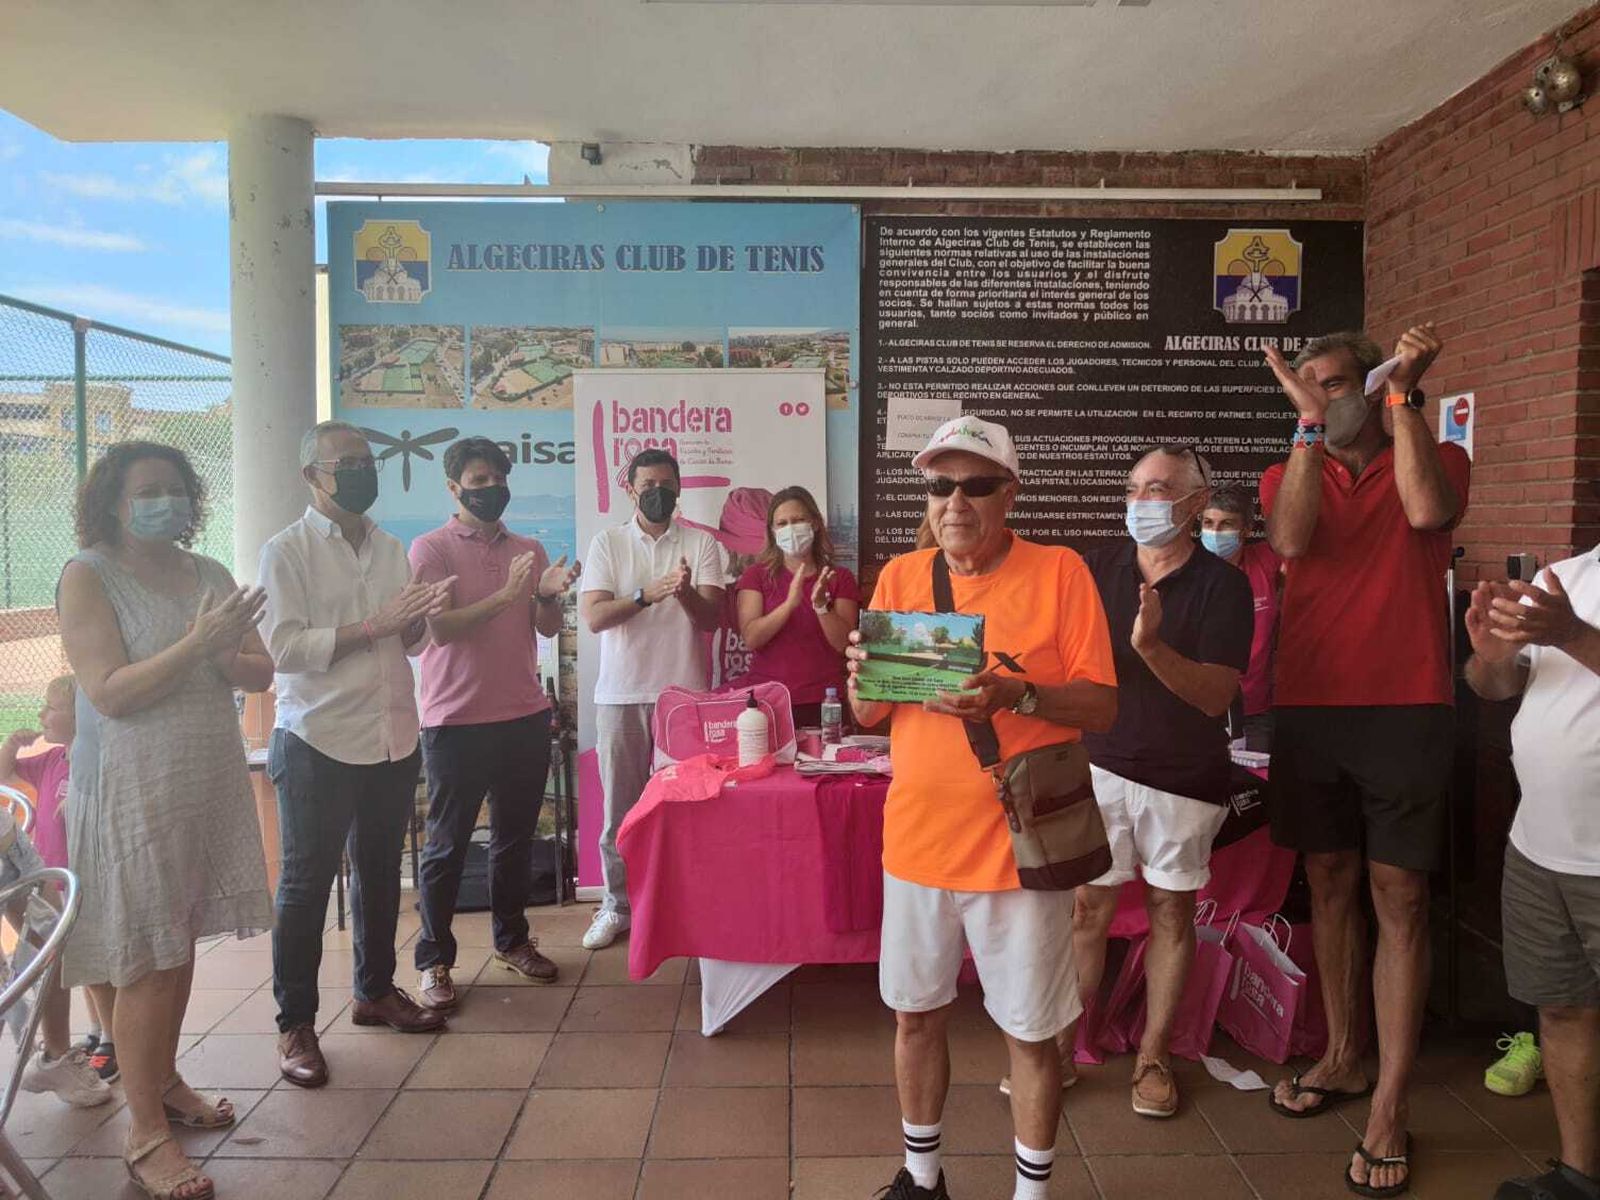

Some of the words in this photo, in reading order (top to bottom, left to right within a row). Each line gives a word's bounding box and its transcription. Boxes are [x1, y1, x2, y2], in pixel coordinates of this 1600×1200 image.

[880, 227, 894, 236] De
[896, 228, 938, 237] acuerdo
[964, 228, 979, 237] los
[982, 228, 1026, 238] vigentes
[1029, 228, 1077, 238] Estatutos
[1080, 231, 1086, 240] y
[1090, 229, 1151, 240] Reglamento
[880, 238, 916, 246] Interno
[919, 238, 931, 246] de
[935, 238, 982, 248] Algeciras
[986, 238, 1010, 247] Club
[1013, 239, 1025, 247] de
[1030, 239, 1058, 249] Tenis,
[1078, 240, 1132, 248] establecen
[1136, 240, 1150, 248] las
[446, 243, 605, 272] ALGECIRAS
[615, 244, 686, 272] CLUB
[695, 244, 735, 273] DE
[744, 244, 825, 274] TENIS
[879, 248, 932, 258] siguientes
[975, 249, 1017, 257] relativas
[1020, 249, 1028, 258] al
[1052, 249, 1064, 258] de
[1066, 249, 1080, 258] las
[1084, 249, 1150, 258] instalaciones
[879, 258, 928, 268] generales
[948, 258, 975, 268] Club,
[1010, 260, 1051, 269] objetivo
[1053, 260, 1065, 268] de
[1068, 260, 1105, 268] facilitar
[1108, 260, 1116, 268] la
[1119, 260, 1150, 269] buena
[879, 268, 949, 276] convivencia
[993, 269, 1010, 277] los
[1074, 272, 1080, 280] y
[1104, 271, 1150, 279] disfrute
[880, 278, 947, 288] responsables
[950, 278, 962, 287] de
[964, 278, 978, 287] las
[981, 279, 1031, 288] diferentes
[1034, 280, 1103, 290] instalaciones,
[1106, 281, 1150, 290] teniendo
[894, 289, 928, 297] cuenta
[931, 289, 943, 297] de
[946, 289, 975, 297] forma
[978, 289, 1027, 299] prioritaria
[1030, 290, 1039, 298] el
[1042, 290, 1076, 298] interés
[1078, 291, 1116, 301] general
[1119, 291, 1131, 300] de
[1134, 291, 1149, 300] los
[920, 299, 933, 307] Se
[938, 299, 968, 307] hallan
[973, 300, 1010, 309] sujetos
[1100, 301, 1129, 309] todos
[1134, 302, 1149, 310] los
[879, 309, 926, 319] usuarios,
[930, 310, 956, 318] tanto
[961, 310, 994, 318] socios
[1032, 310, 1078, 319] invitados
[1084, 313, 1089, 321] y
[1094, 311, 1131, 322] público
[879, 320, 918, 329] general.
[1164, 336, 1240, 350] ALGECIRAS
[1244, 336, 1279, 351] CLUB
[1283, 337, 1302, 351] DE
[613, 400, 732, 433] bandera
[496, 433, 575, 464] aisa
[724, 653, 753, 670] ros
